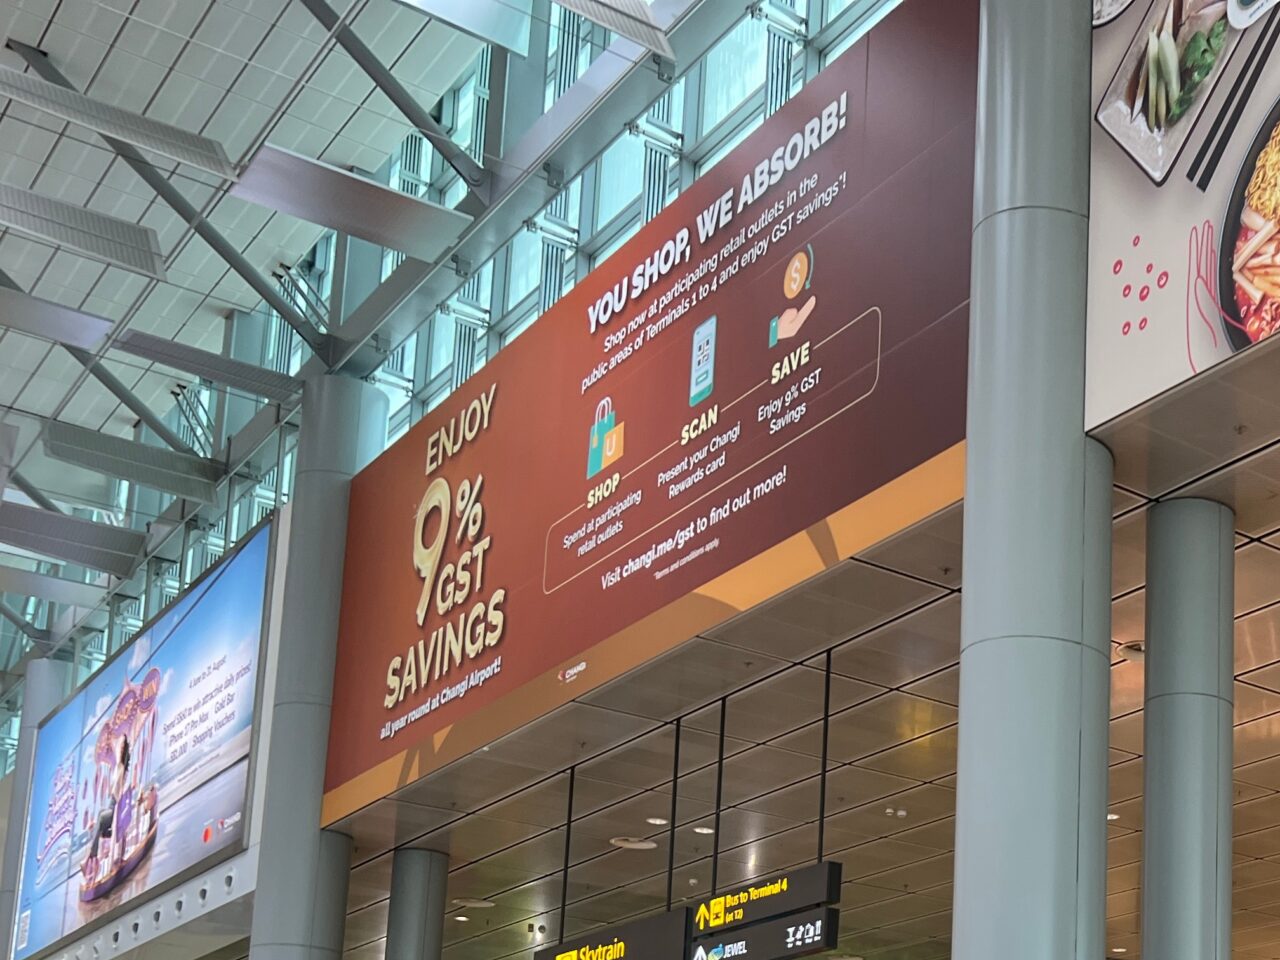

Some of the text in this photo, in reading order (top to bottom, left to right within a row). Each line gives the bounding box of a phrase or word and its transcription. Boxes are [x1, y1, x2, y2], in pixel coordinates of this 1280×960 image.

[587, 91, 848, 334] YOU SHOP, WE ABSORB!
[604, 173, 818, 352] Shop now at participating retail outlets in the
[581, 364, 608, 394] public
[608, 346, 633, 370] areas
[634, 332, 646, 354] of
[645, 301, 690, 342] Terminals
[691, 297, 698, 311] 1
[699, 282, 709, 300] to
[710, 275, 718, 292] 4
[719, 259, 739, 285] and
[740, 237, 770, 273] enjoy
[771, 218, 795, 242] GST
[770, 342, 811, 385] SAVE
[757, 367, 823, 423] Enjoy 9% GST
[769, 402, 807, 435] Savings
[425, 383, 497, 476] ENJOY
[681, 404, 719, 446] SCAN
[657, 421, 741, 488] Present your Changi
[668, 452, 726, 499] Rewards card
[563, 489, 642, 549] Spend at participating
[586, 473, 620, 509] SHOP
[577, 520, 624, 557] retail outlets
[601, 464, 788, 590] Visit changi.me/gst to find out more!
[436, 536, 491, 616] GST
[384, 588, 506, 710] SAVINGS
[380, 656, 501, 740] all year round at Changi Airport!
[725, 877, 788, 908] Bus to Terminal 4
[725, 908, 744, 924] (at T2)
[723, 940, 748, 958] JEWEL
